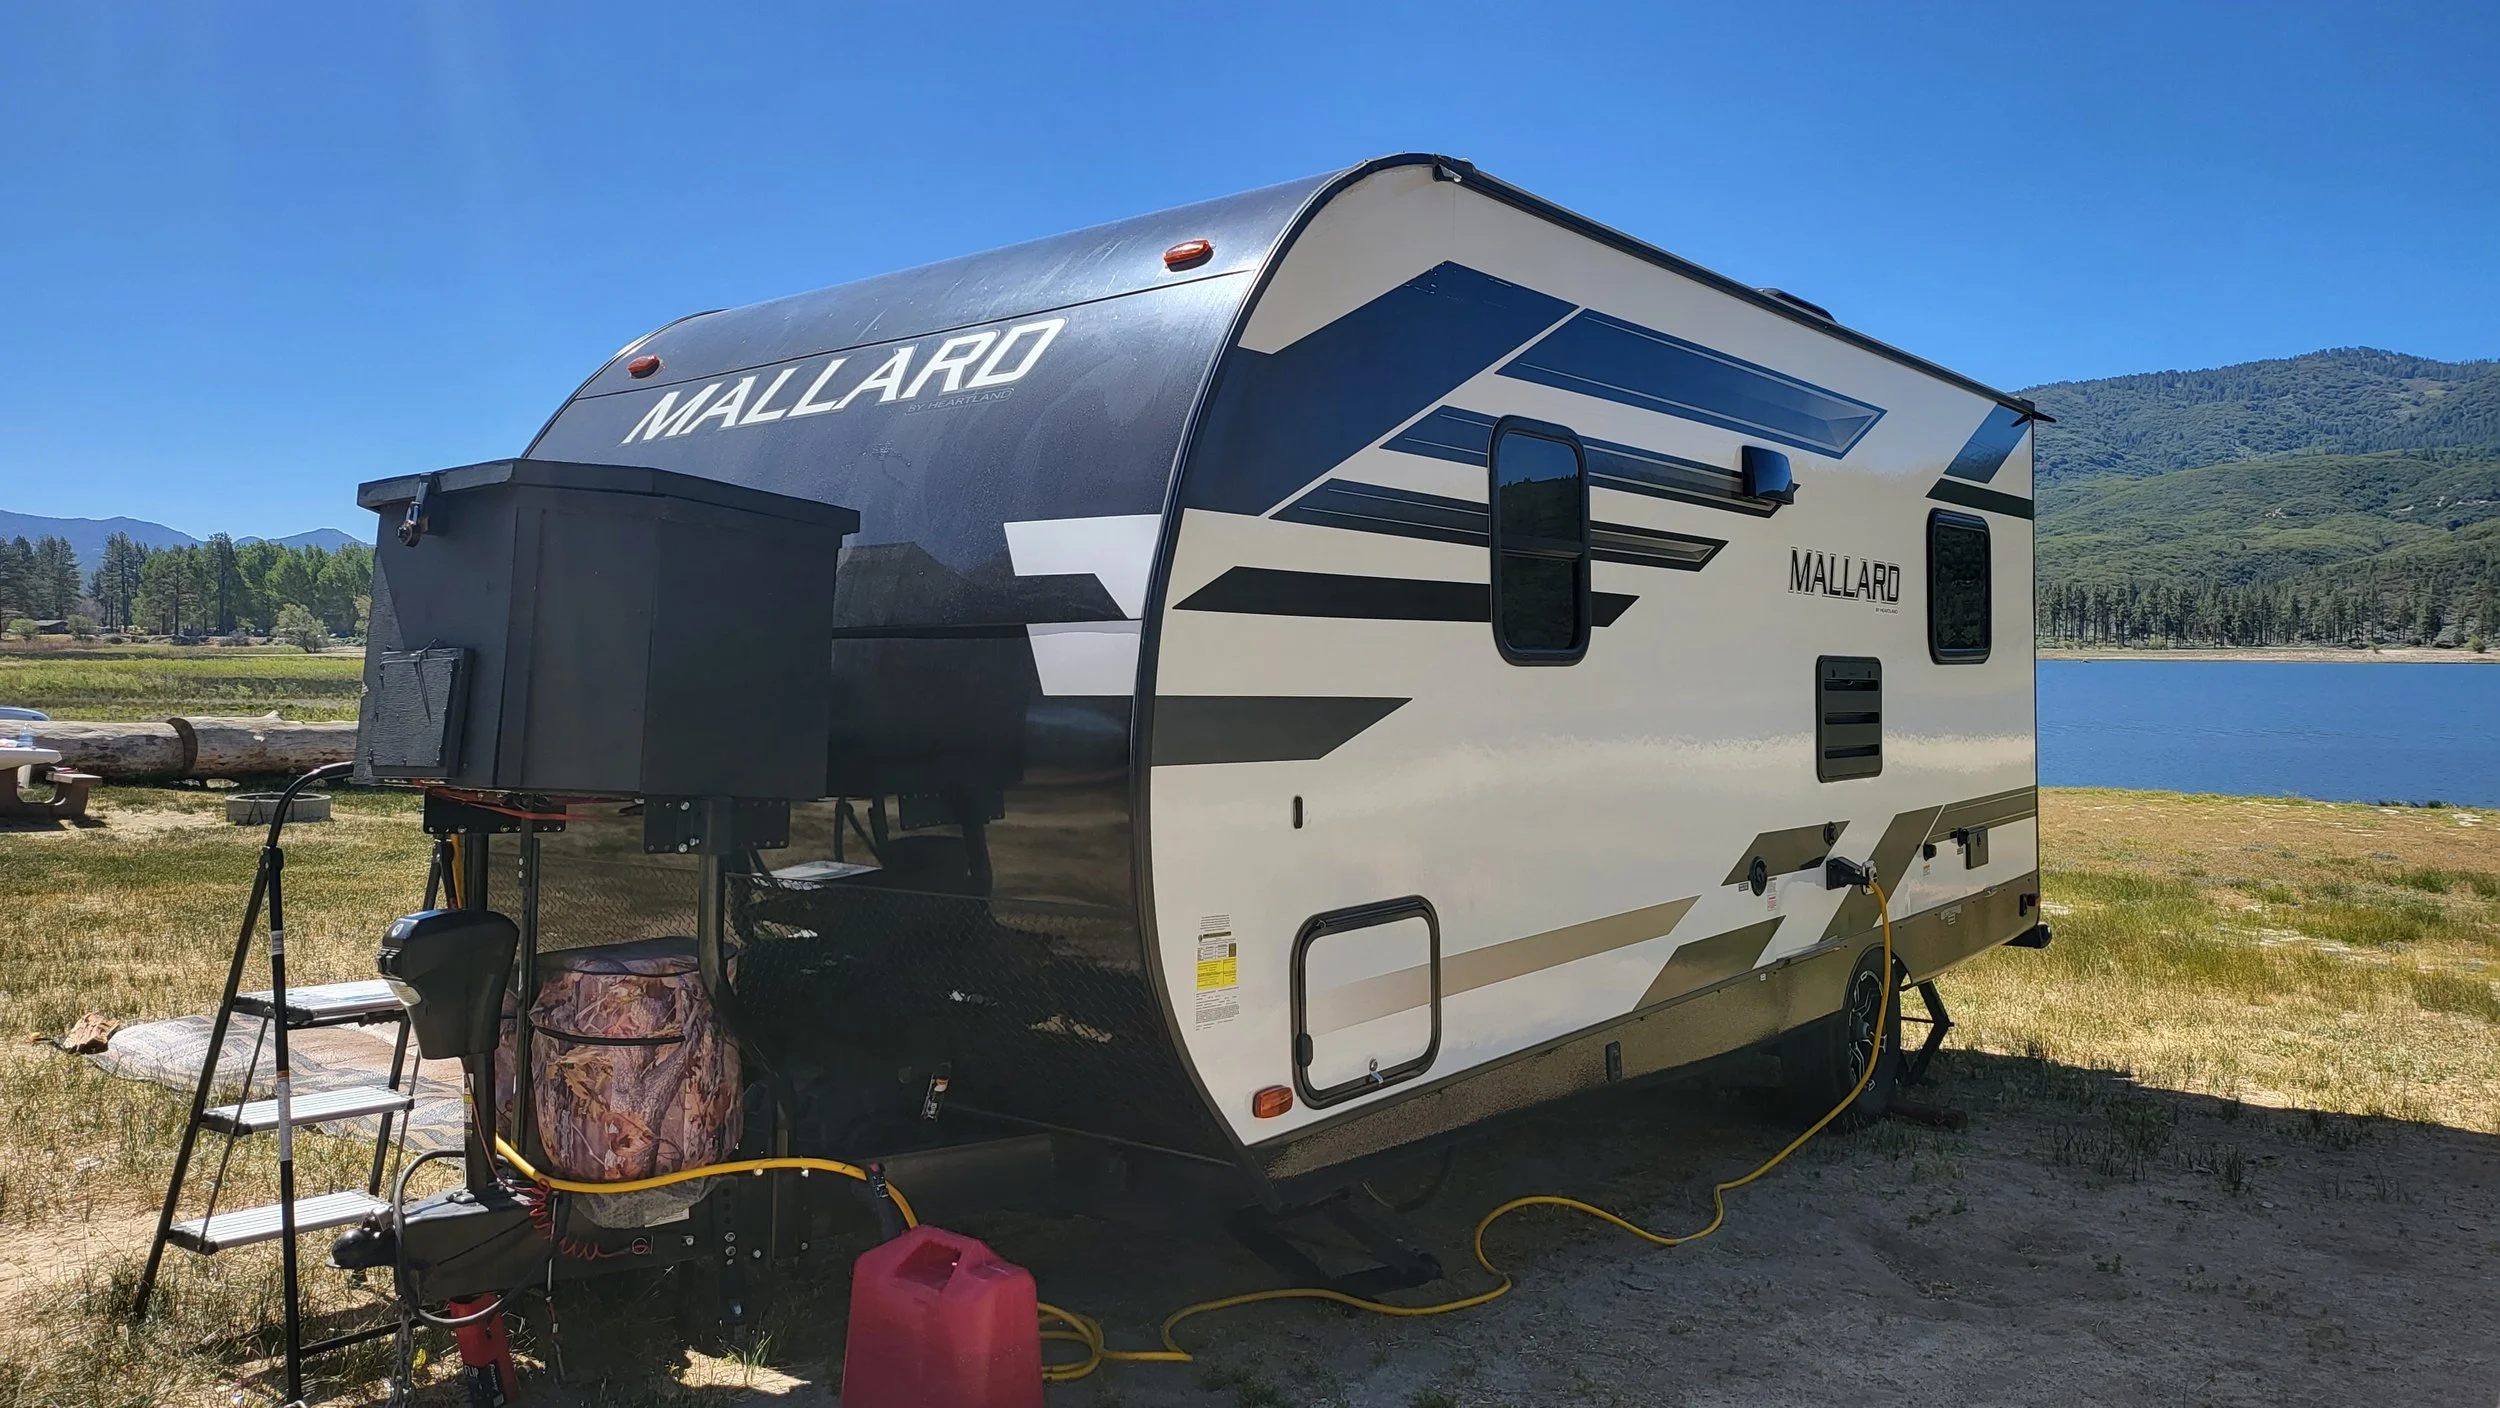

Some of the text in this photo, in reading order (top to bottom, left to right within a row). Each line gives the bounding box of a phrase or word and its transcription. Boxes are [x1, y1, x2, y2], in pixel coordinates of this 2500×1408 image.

[620, 317, 1068, 444] MALLARD
[908, 390, 1012, 413] BY HEARTLAND
[1789, 547, 1900, 604] MALLARD
[464, 1365, 480, 1378] FLIP
